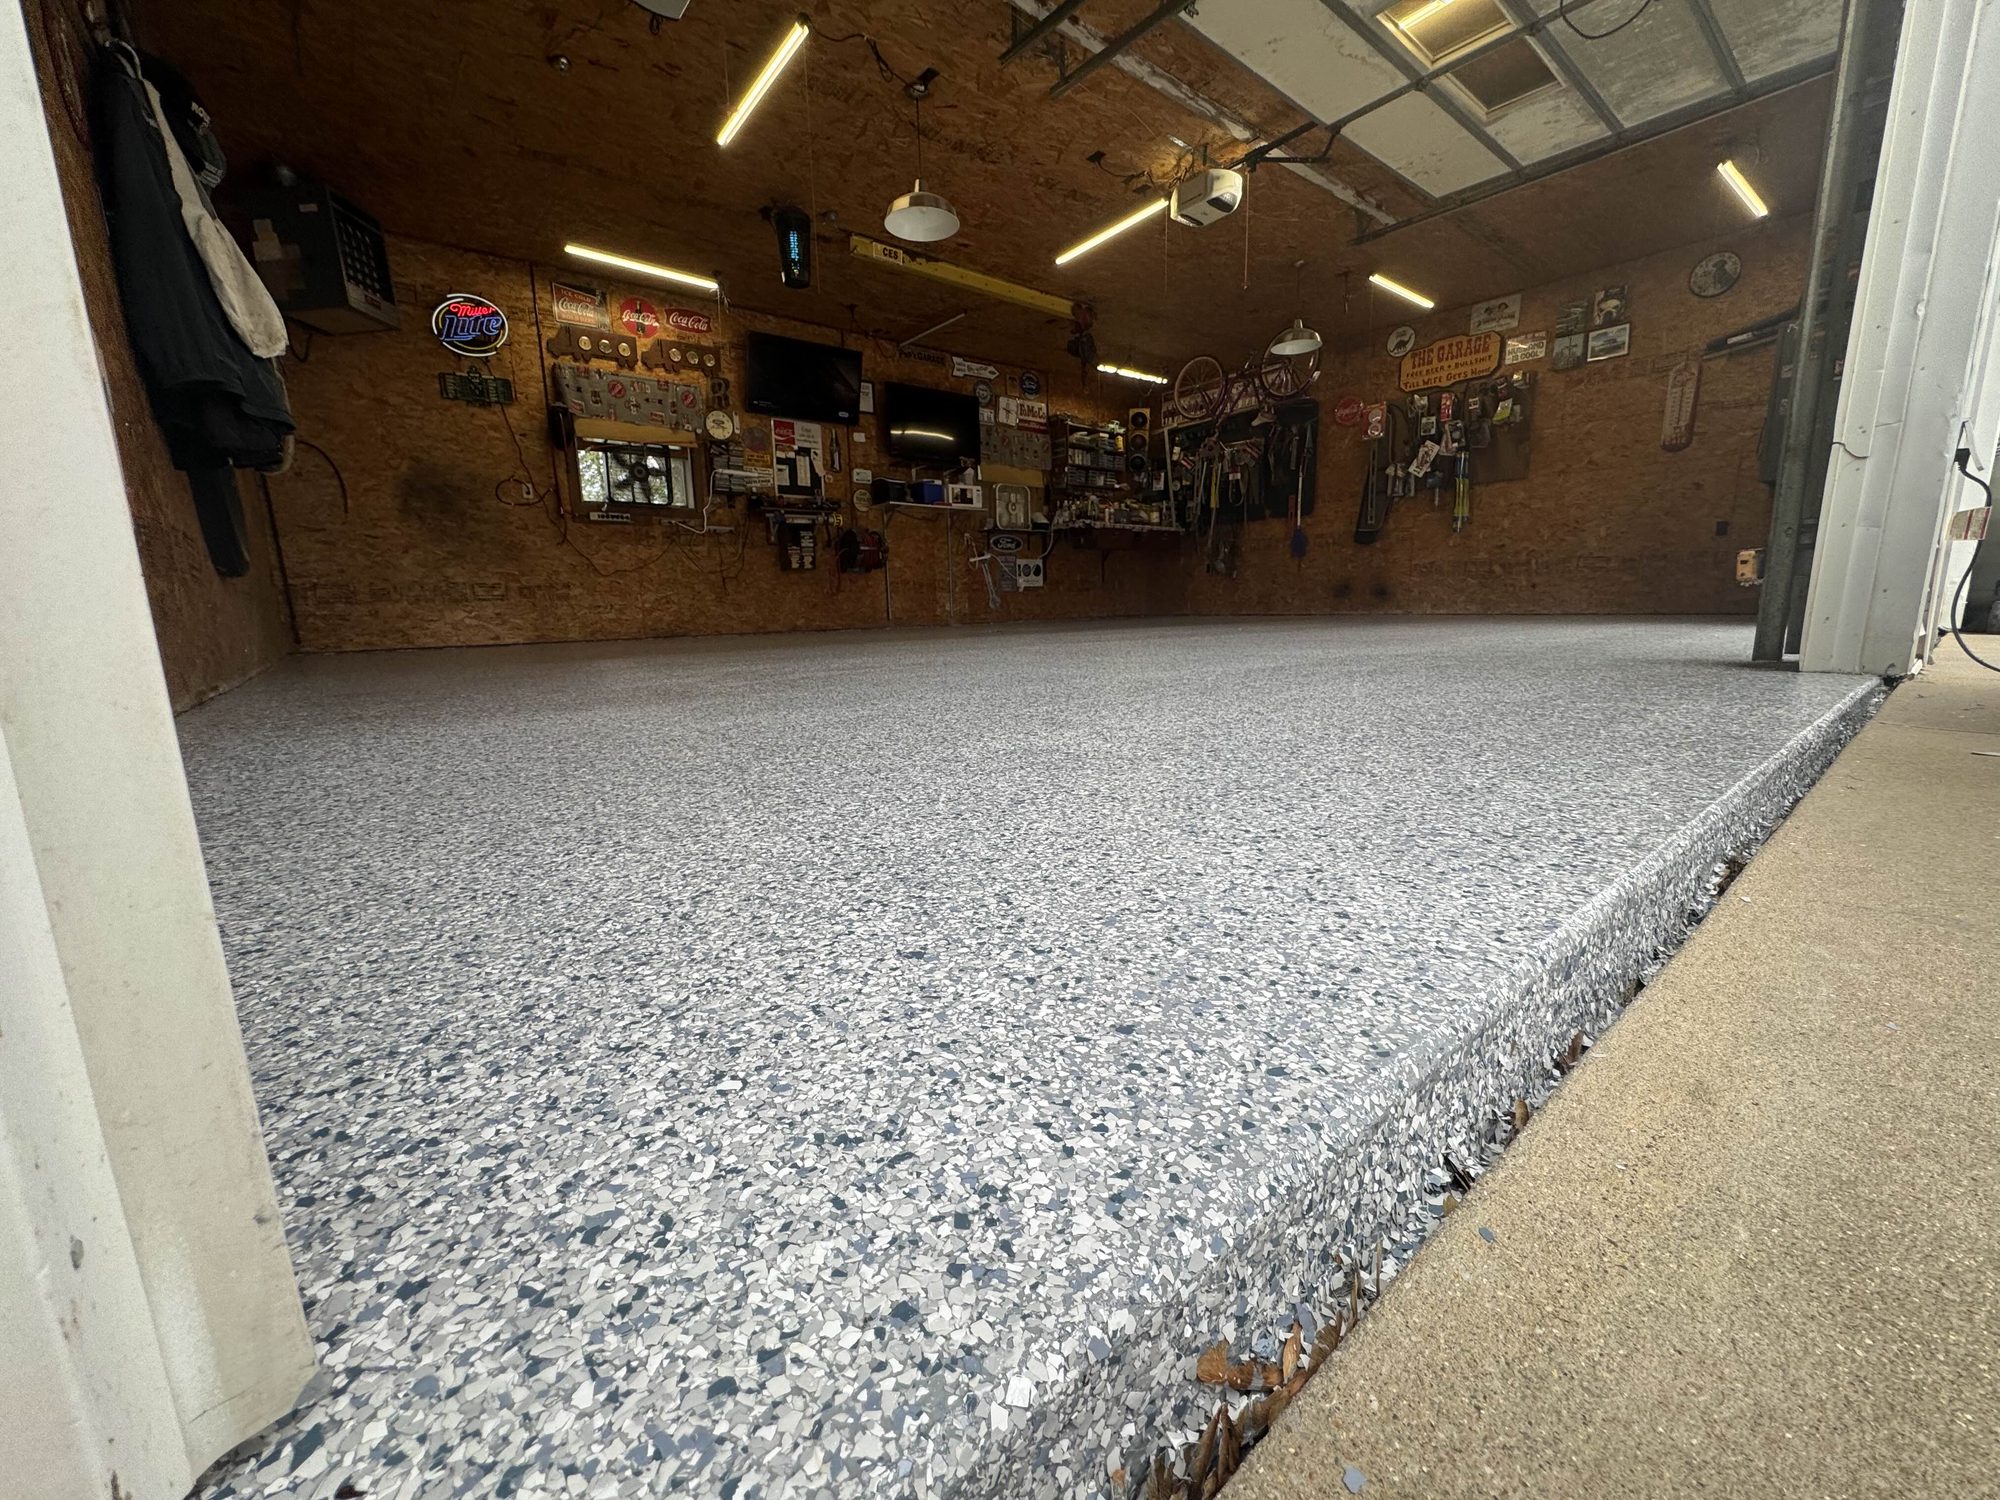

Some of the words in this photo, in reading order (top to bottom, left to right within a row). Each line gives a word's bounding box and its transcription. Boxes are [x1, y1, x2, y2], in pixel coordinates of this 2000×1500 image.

[883, 247, 898, 260] CES
[450, 303, 496, 317] Miller
[440, 315, 502, 341] Lite
[1411, 347, 1434, 369] THE
[1437, 334, 1492, 363] GARAGE
[1520, 350, 1540, 360] COOL
